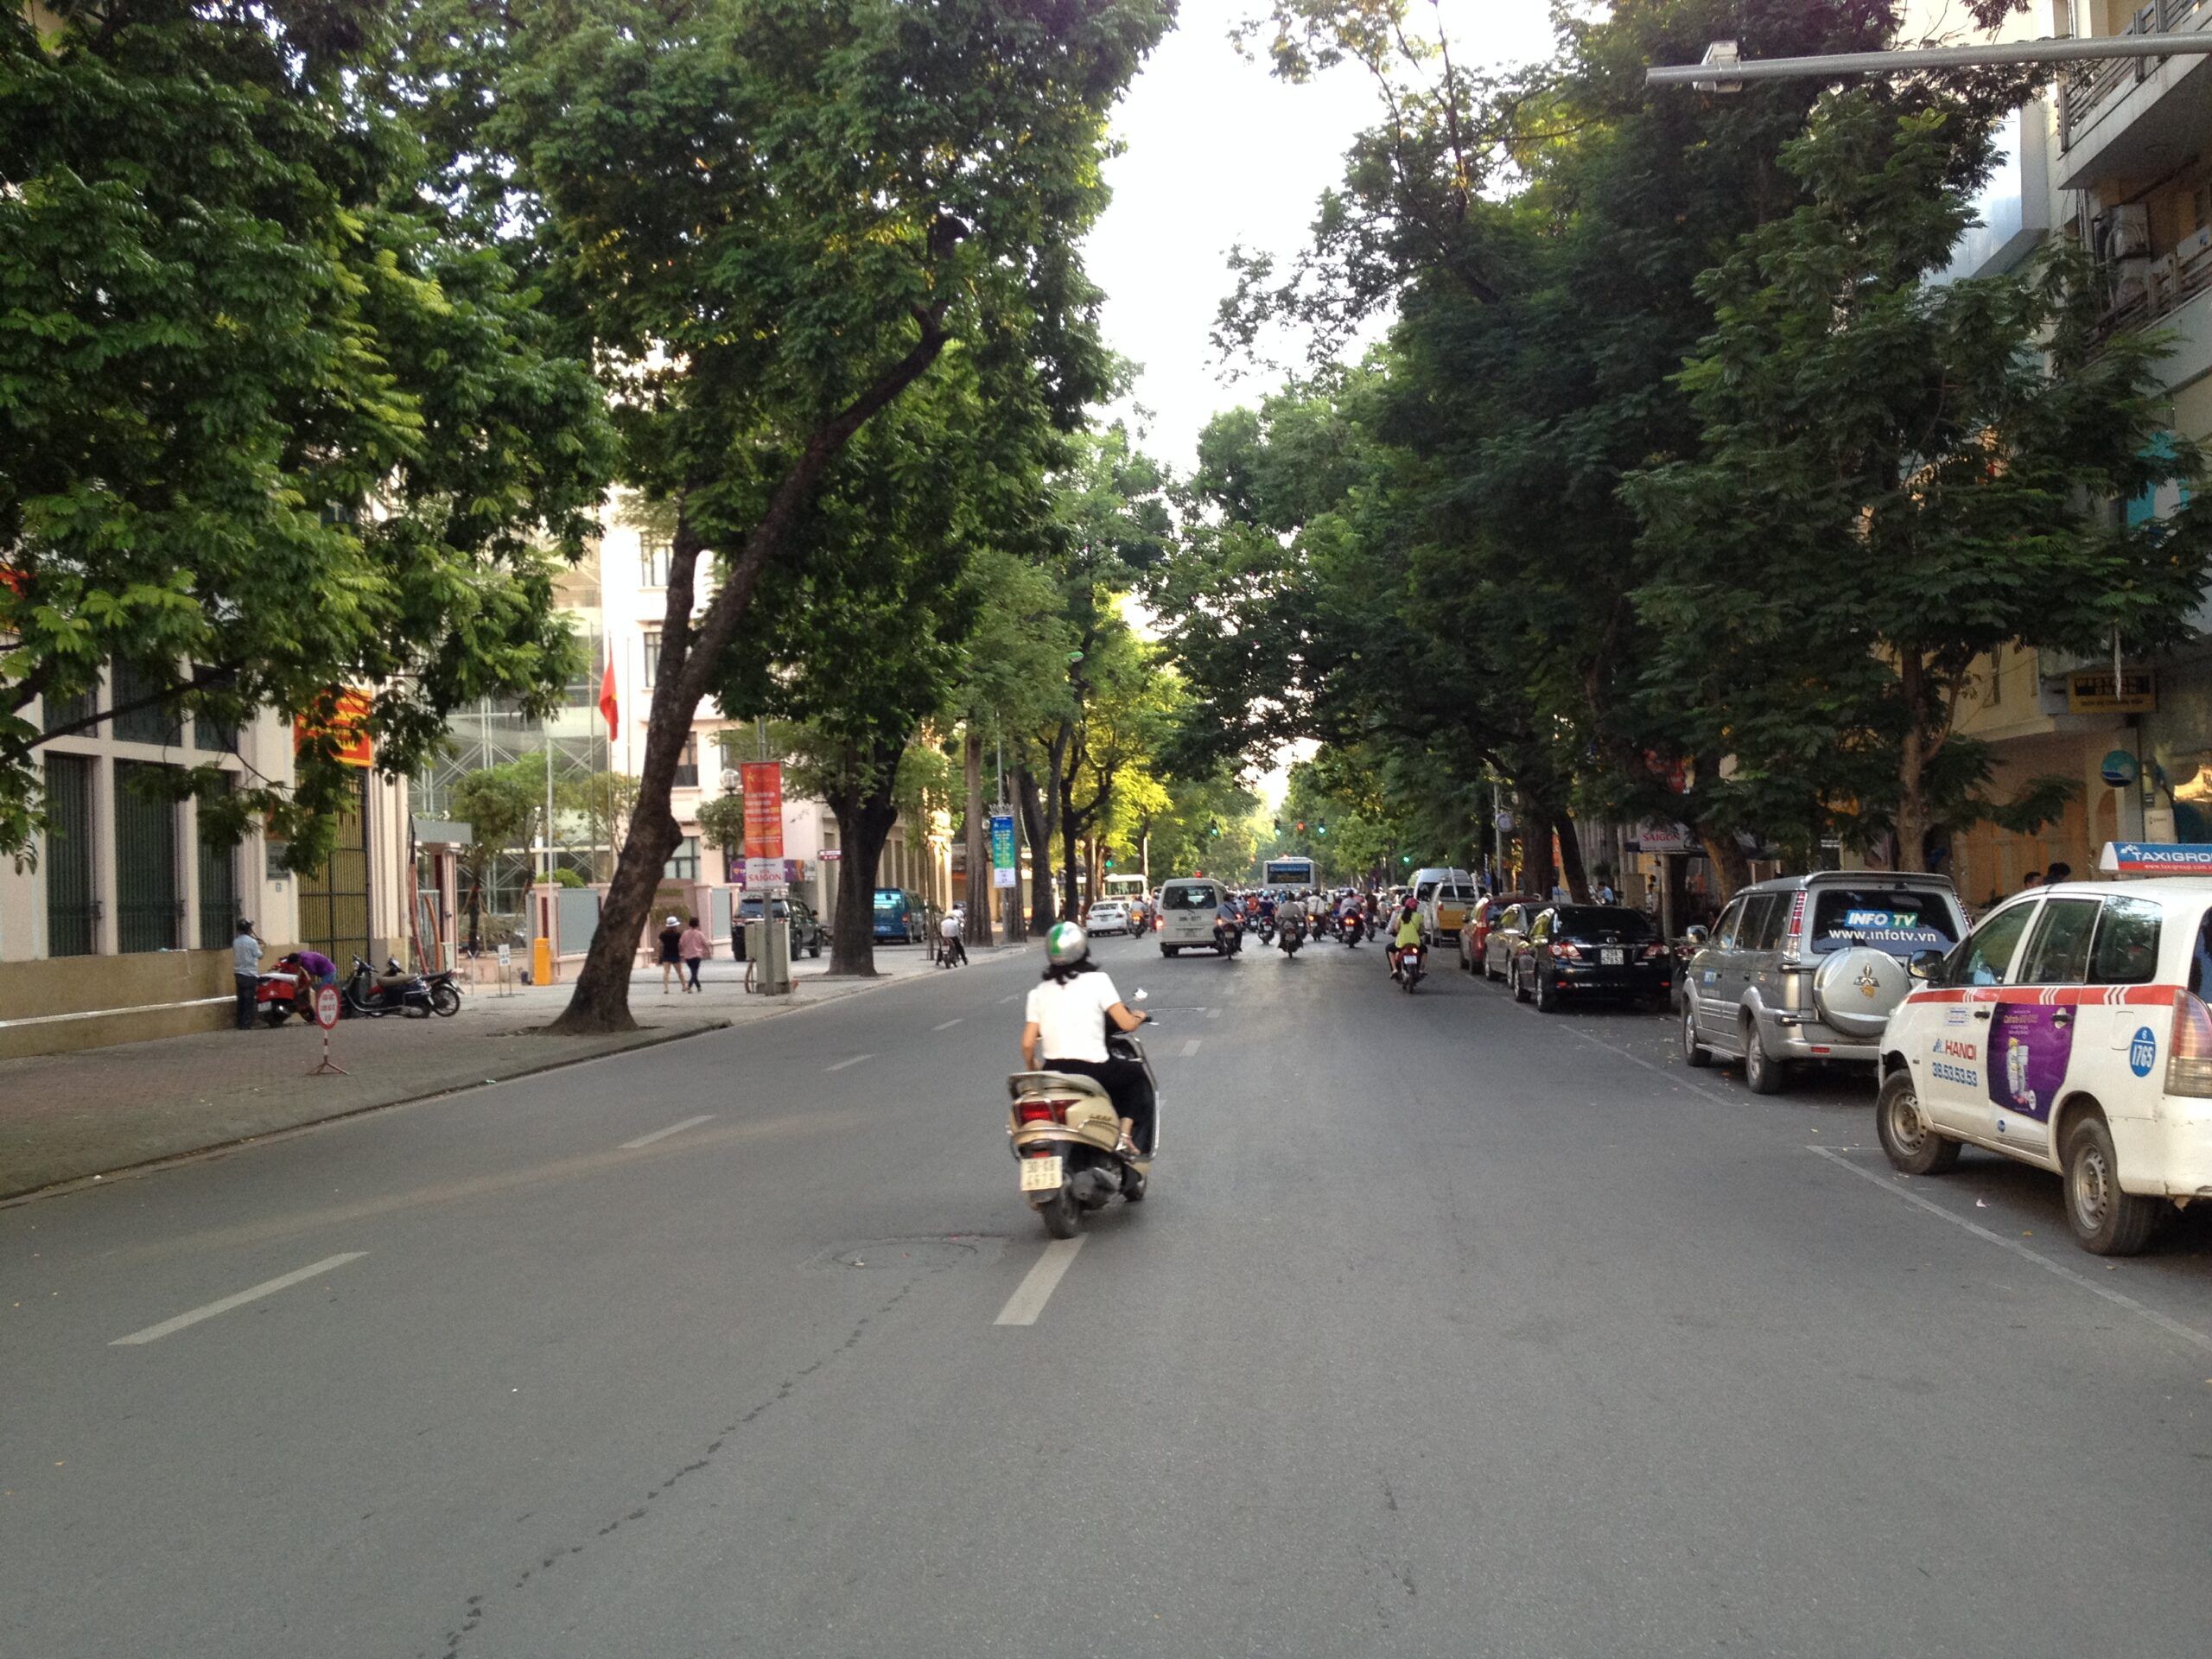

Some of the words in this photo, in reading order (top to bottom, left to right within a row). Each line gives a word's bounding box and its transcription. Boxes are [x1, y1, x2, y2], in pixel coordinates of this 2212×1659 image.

[2094, 686, 2137, 695] UNON
[1643, 833, 1681, 842] SAIGON
[2132, 852, 2212, 862] TAXIGRO
[748, 873, 782, 881] SAIGON
[1847, 912, 1889, 926] INFO
[1893, 914, 1916, 927] TV
[1828, 929, 1936, 943] www.infotv.vn
[1945, 1039, 1977, 1061] HANOI
[2132, 1044, 2153, 1068] 1765
